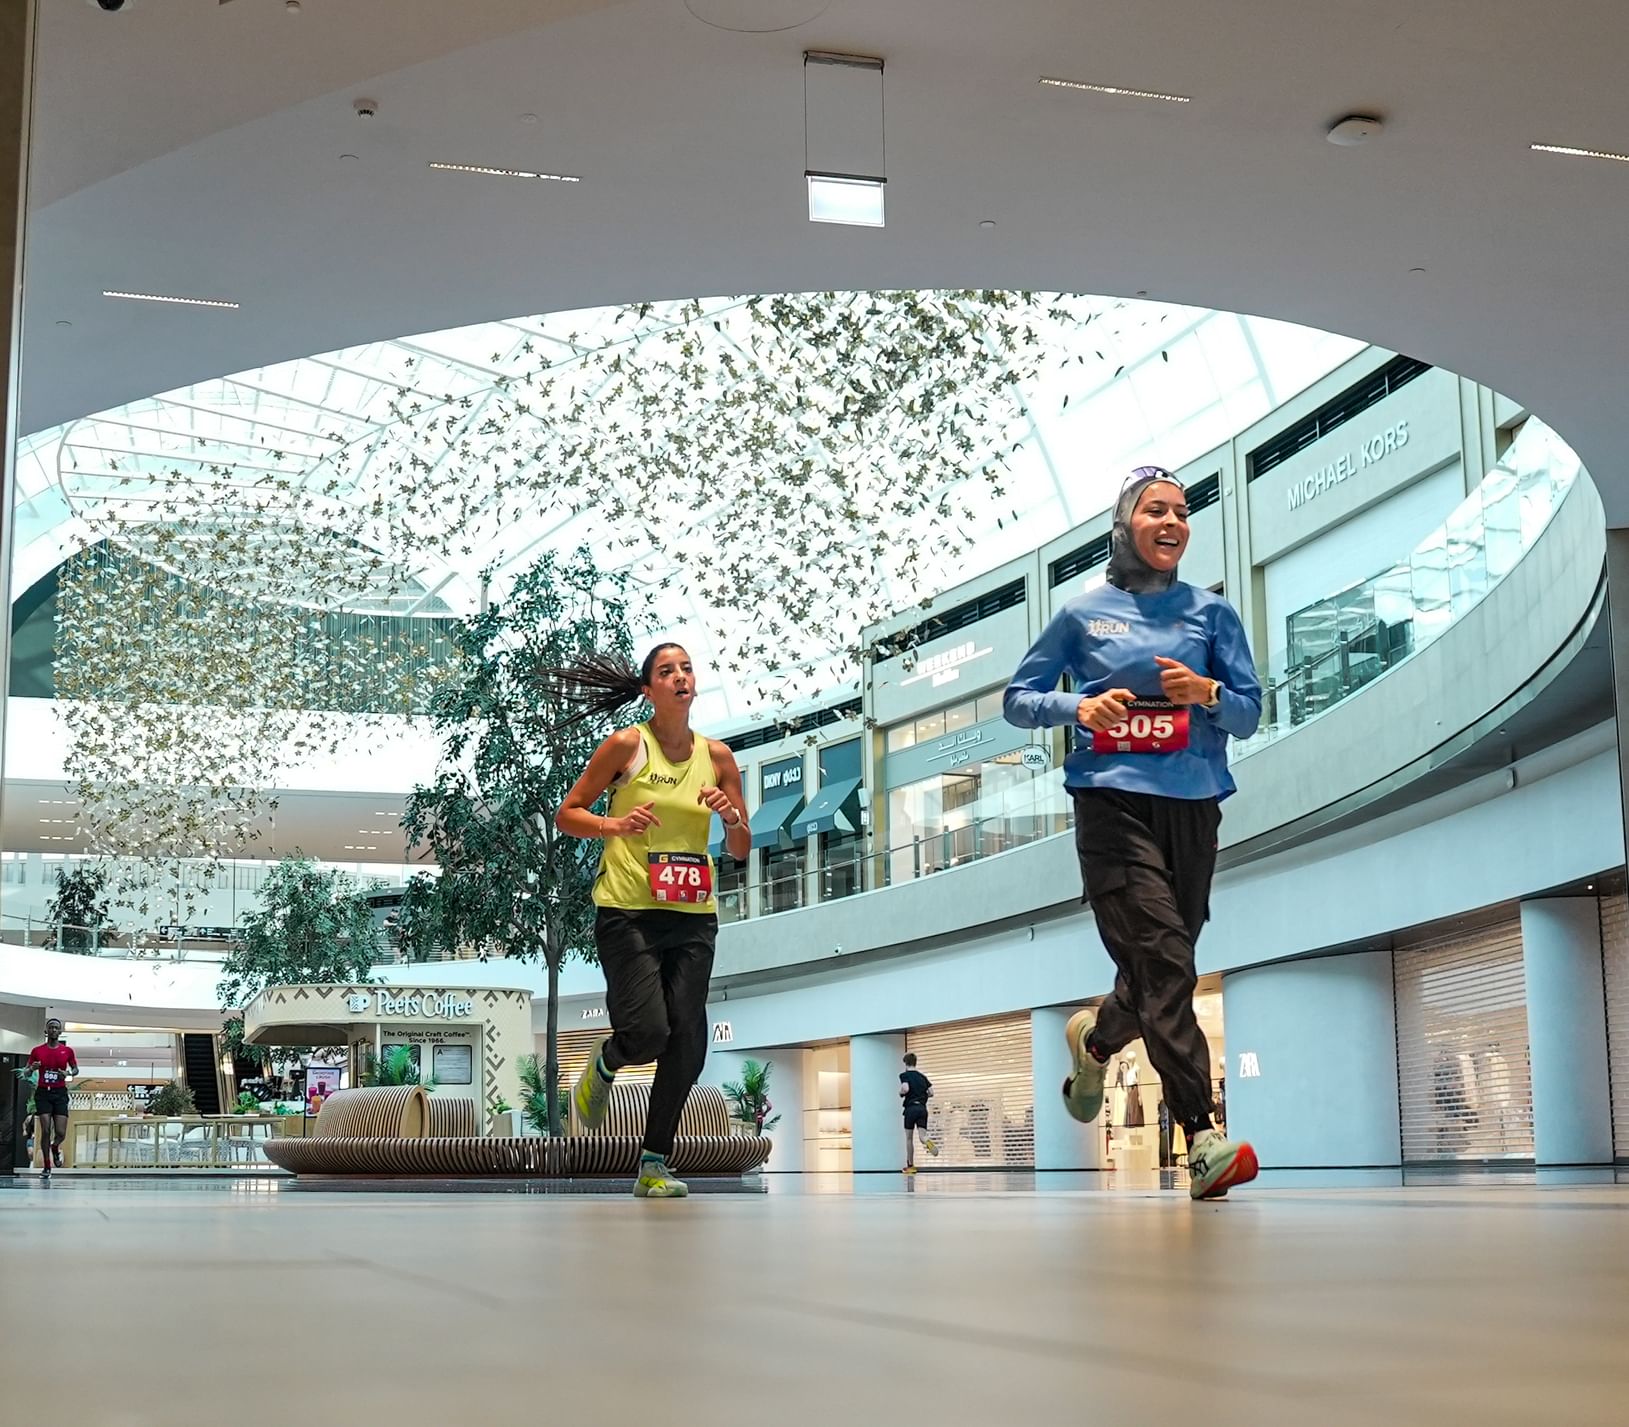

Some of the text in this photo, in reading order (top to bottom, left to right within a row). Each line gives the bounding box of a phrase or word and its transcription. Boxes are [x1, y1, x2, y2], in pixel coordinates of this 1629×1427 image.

[1288, 419, 1409, 511] MICHAEL KORS
[1107, 714, 1174, 738] 505
[1024, 754, 1045, 762] KARL
[764, 772, 781, 789] DKNY
[659, 865, 701, 887] 478
[375, 990, 473, 1020] Peet's Coffee
[581, 1008, 604, 1020] ZARA
[383, 1030, 396, 1038] The
[397, 1030, 424, 1038] Original
